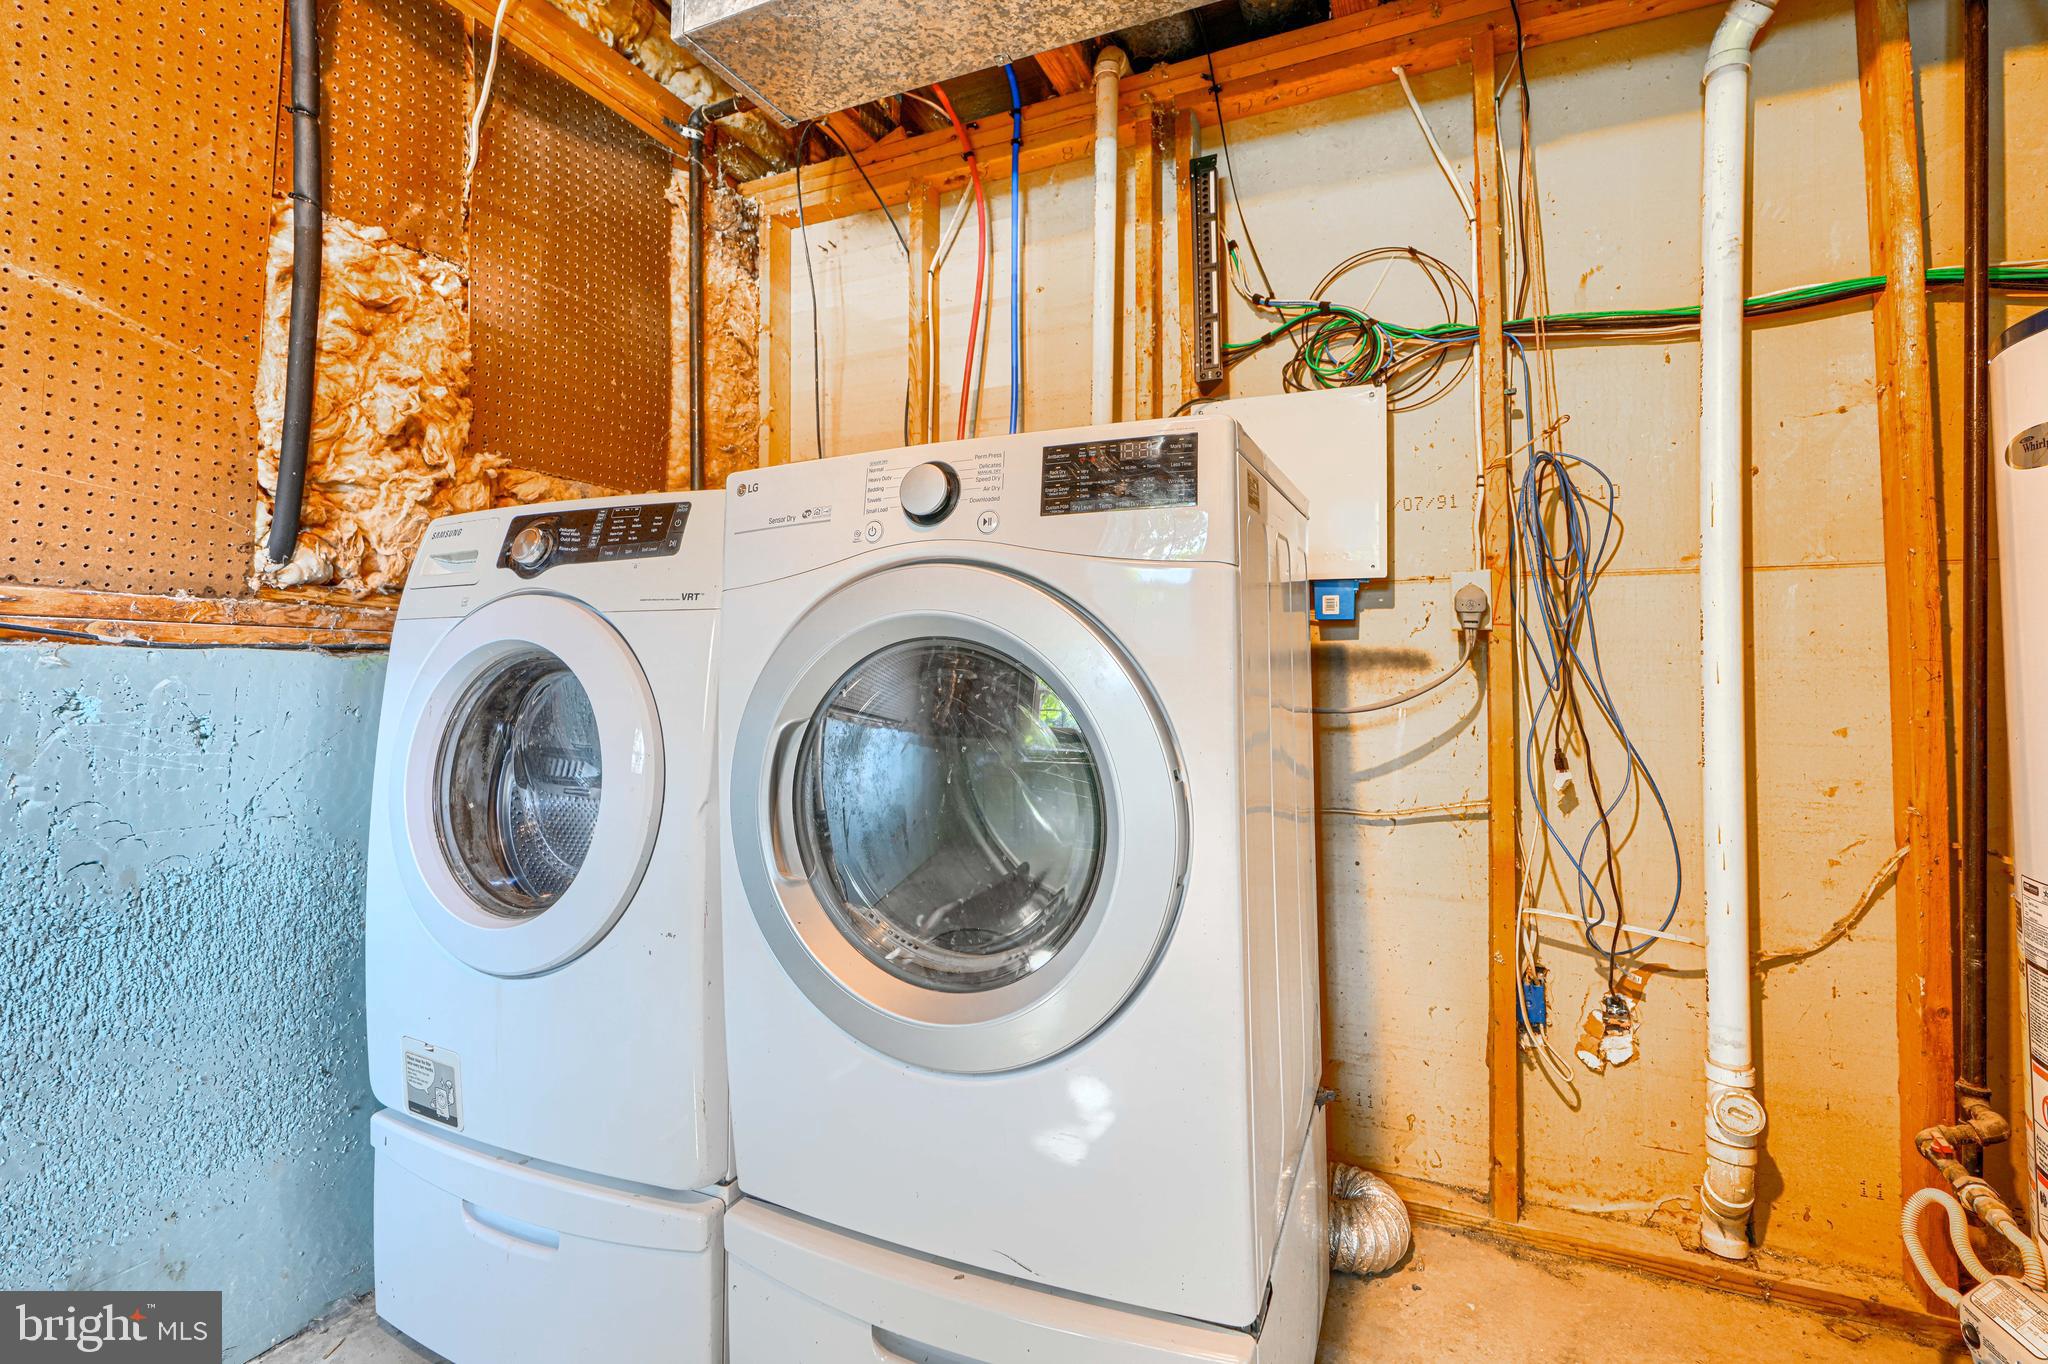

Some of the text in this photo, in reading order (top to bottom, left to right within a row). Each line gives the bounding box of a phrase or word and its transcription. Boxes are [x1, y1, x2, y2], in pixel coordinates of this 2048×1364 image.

[2022, 437, 2048, 453] Whirl
[748, 483, 759, 494] LG
[969, 495, 1001, 504] Downloaded
[768, 514, 796, 525] Sensor Dry
[431, 528, 463, 540] SAMSUNG
[681, 592, 701, 601] VRT
